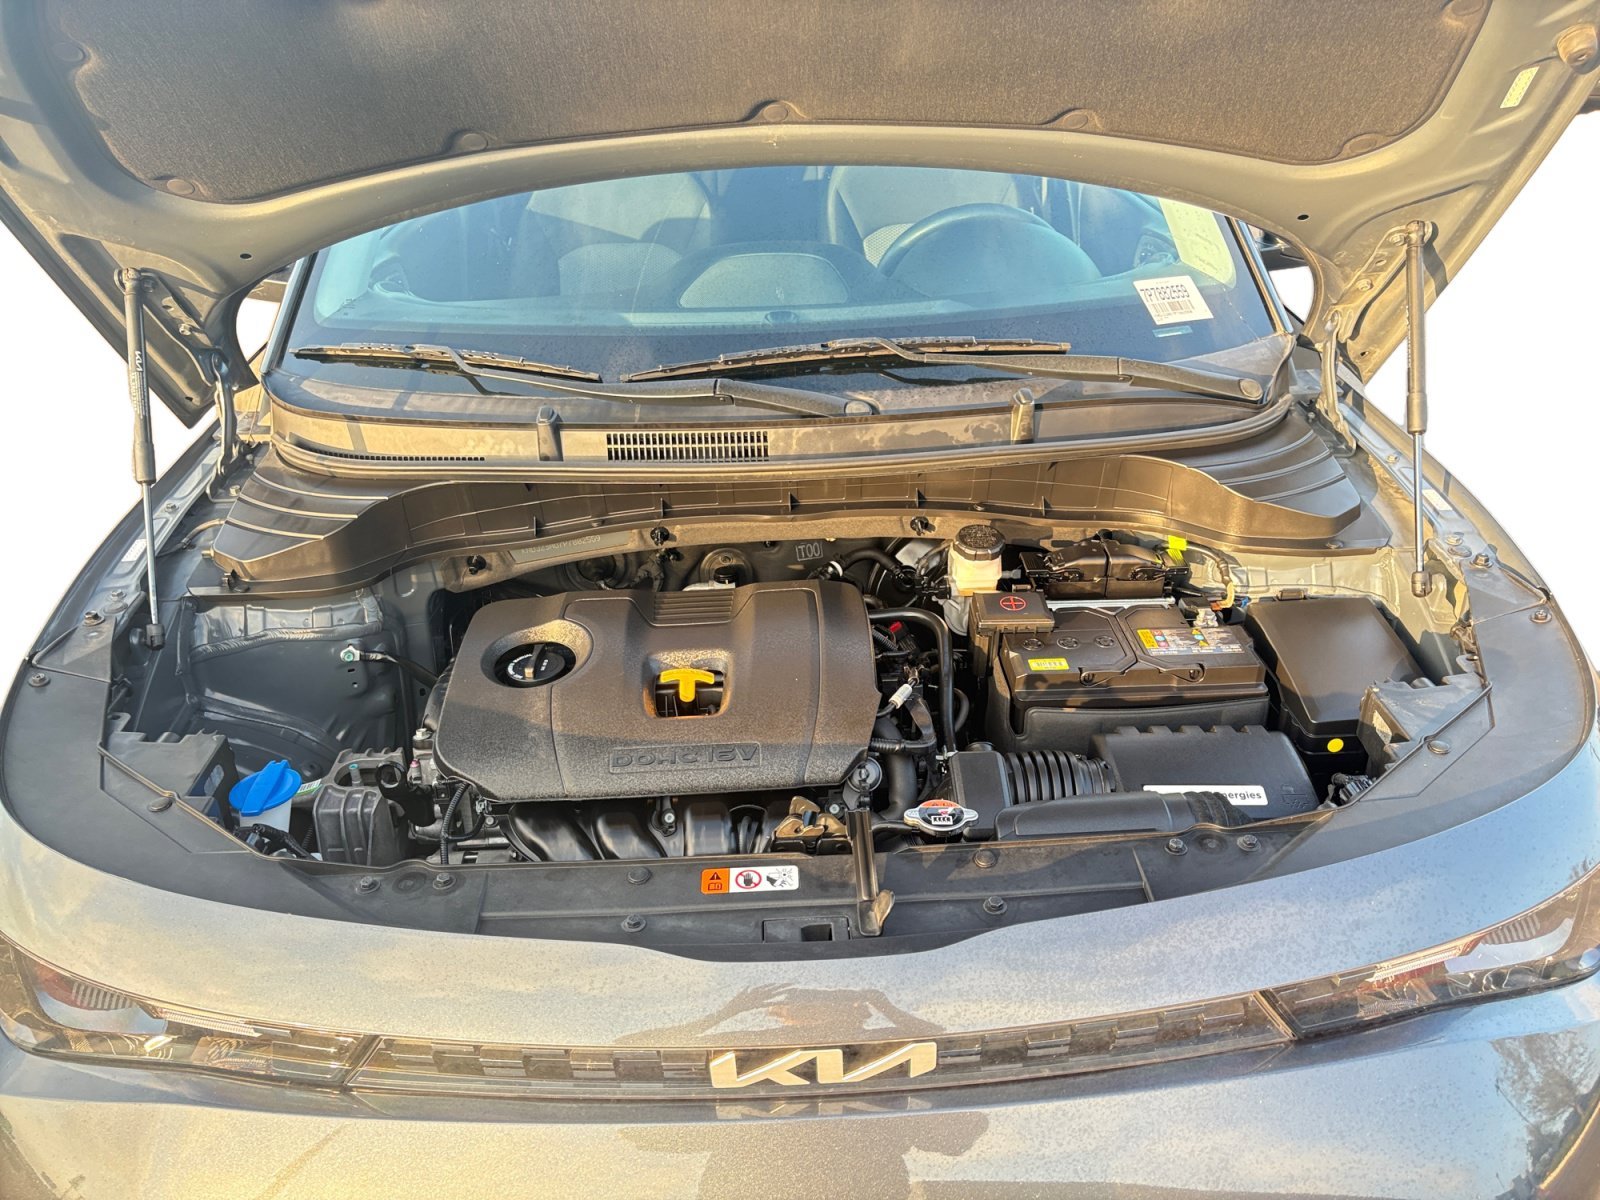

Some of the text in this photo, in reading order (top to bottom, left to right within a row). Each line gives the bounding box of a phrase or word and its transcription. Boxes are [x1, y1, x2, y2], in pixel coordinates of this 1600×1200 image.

[1139, 284, 1190, 303] 7P7882559
[134, 350, 144, 372] KIA
[611, 745, 759, 768] DOHC 16V
[709, 1041, 937, 1089] KIA
